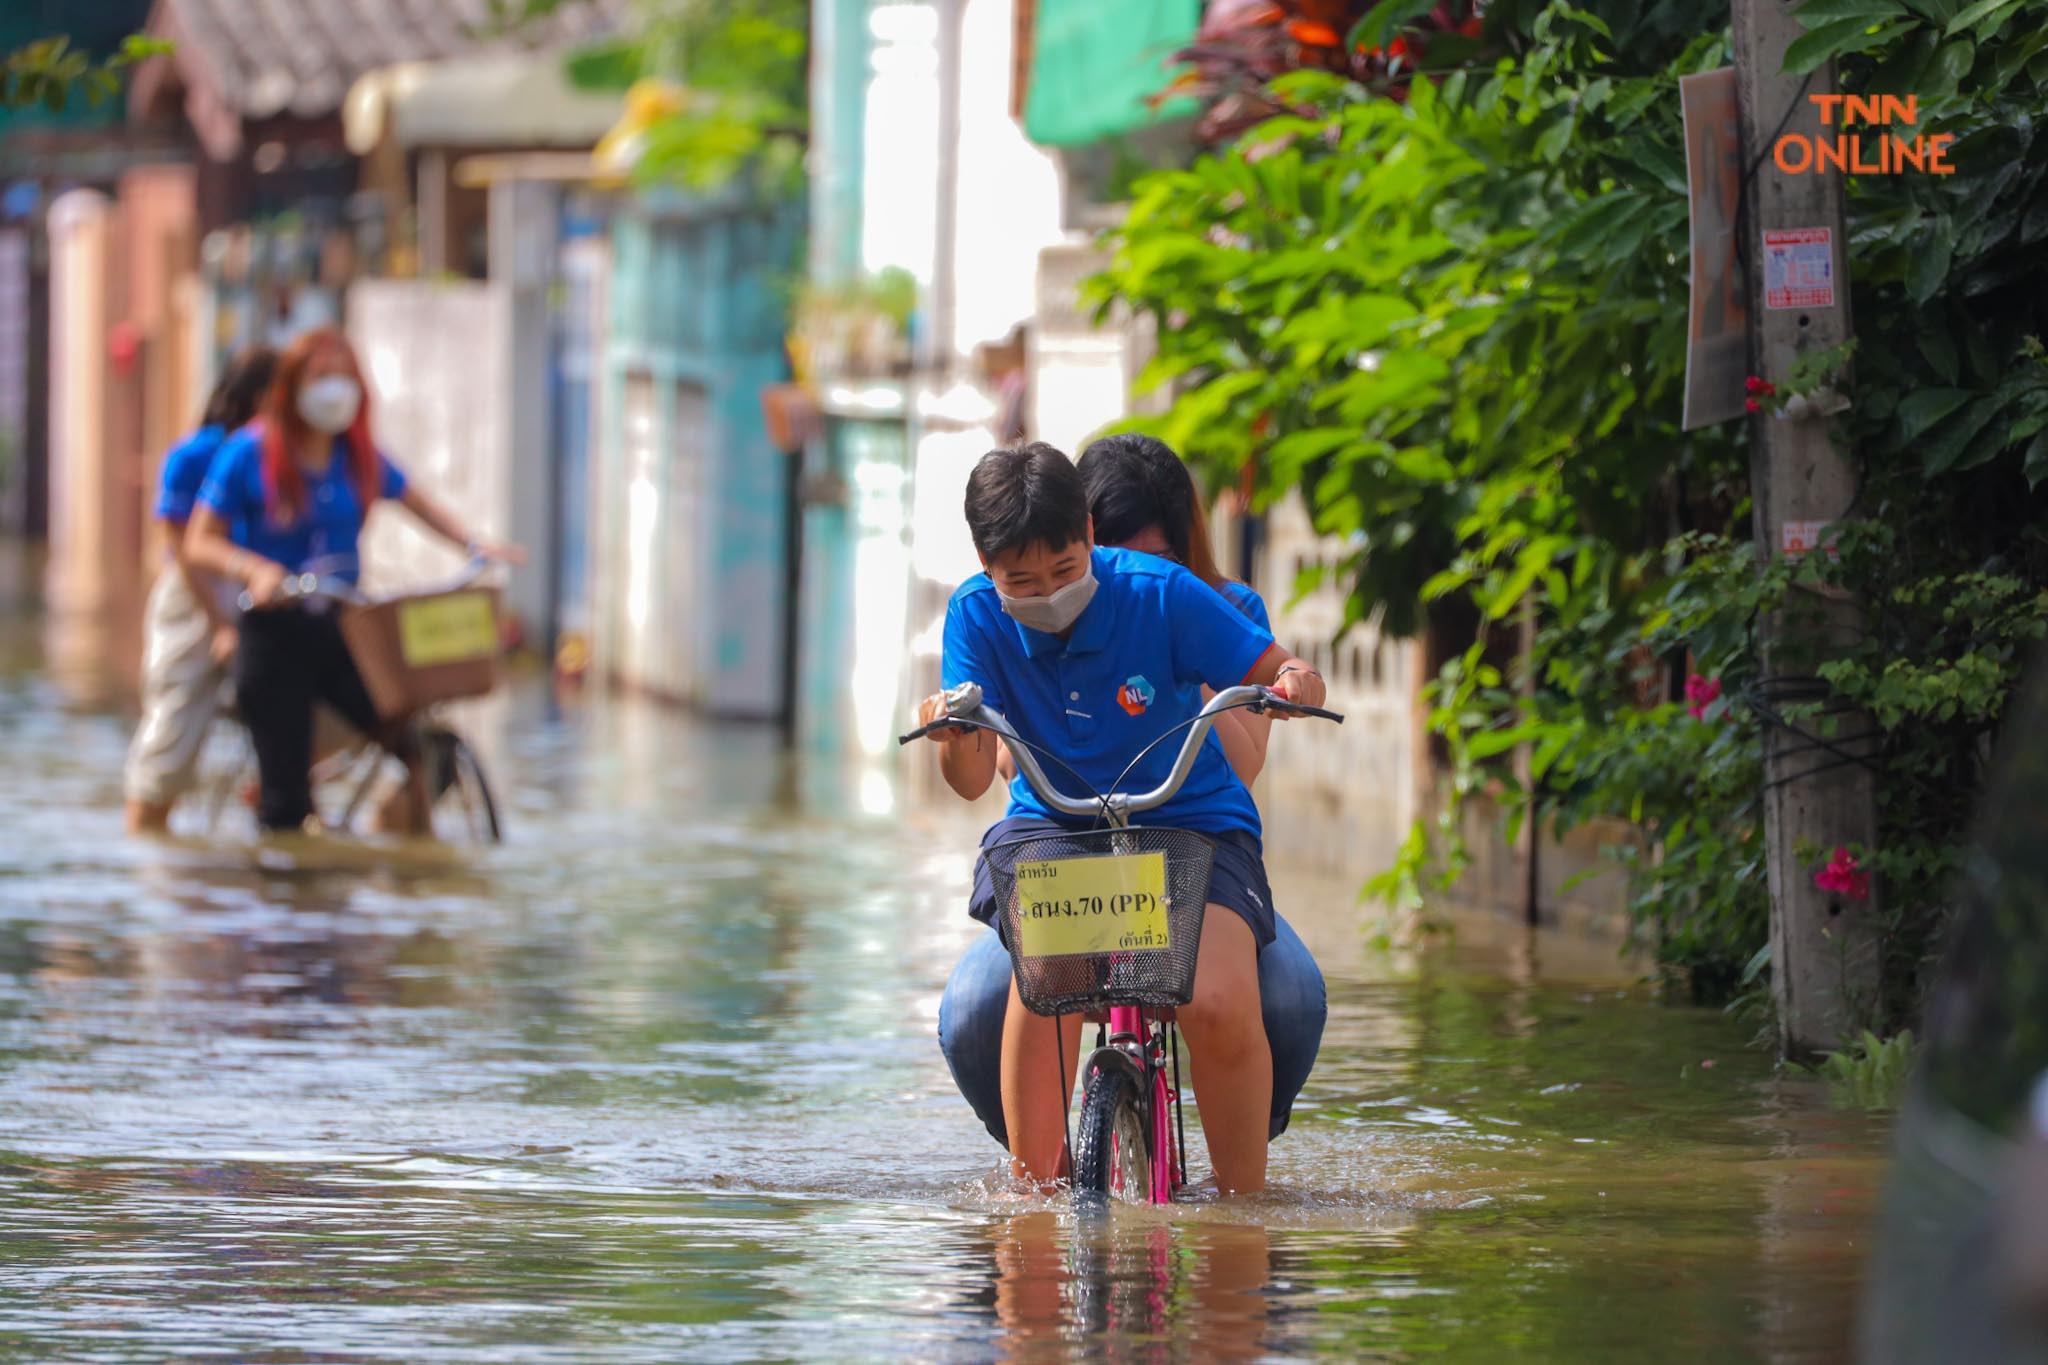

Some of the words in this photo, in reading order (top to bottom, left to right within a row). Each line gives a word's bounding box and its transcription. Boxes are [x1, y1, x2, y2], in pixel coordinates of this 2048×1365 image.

[1125, 687, 1148, 704] NL
[1018, 863, 1057, 879] สำหรับ
[1031, 896, 1103, 919] สนง.70
[1110, 893, 1156, 917] (PP)
[1119, 925, 1153, 949] (คันที่
[1156, 933, 1168, 946] 2)
